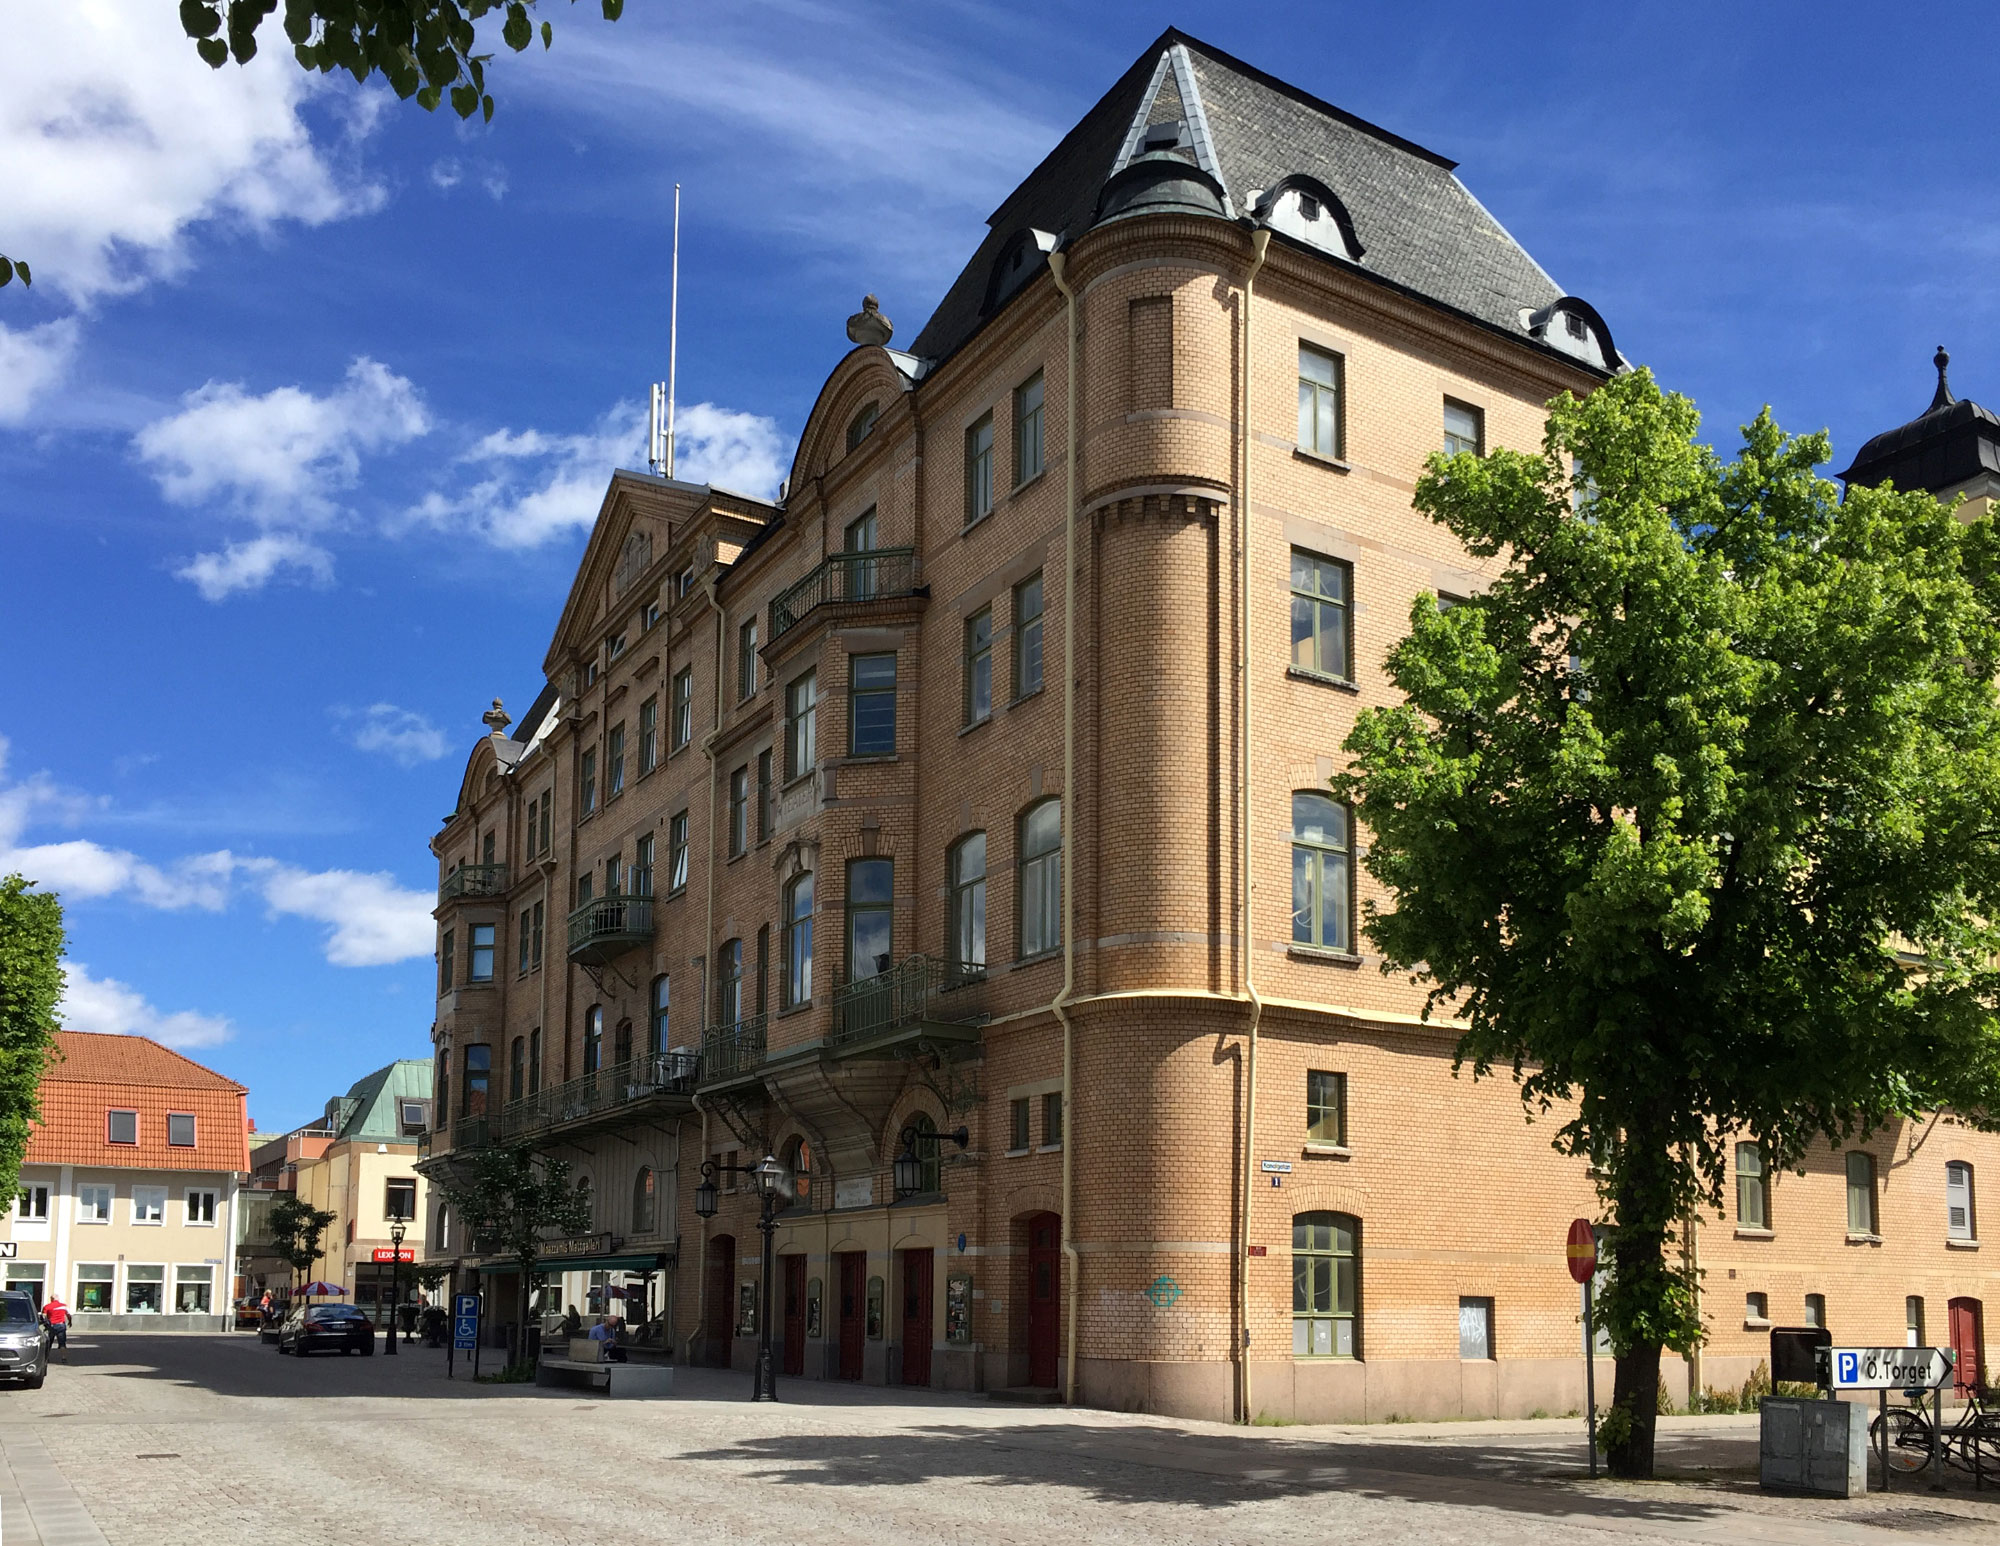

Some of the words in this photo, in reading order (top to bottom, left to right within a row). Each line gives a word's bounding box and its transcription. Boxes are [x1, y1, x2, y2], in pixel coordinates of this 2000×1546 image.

[377, 1251, 412, 1259] LEXION
[1841, 1355, 1855, 1381] P
[1866, 1356, 1932, 1384] Ö.Torget
